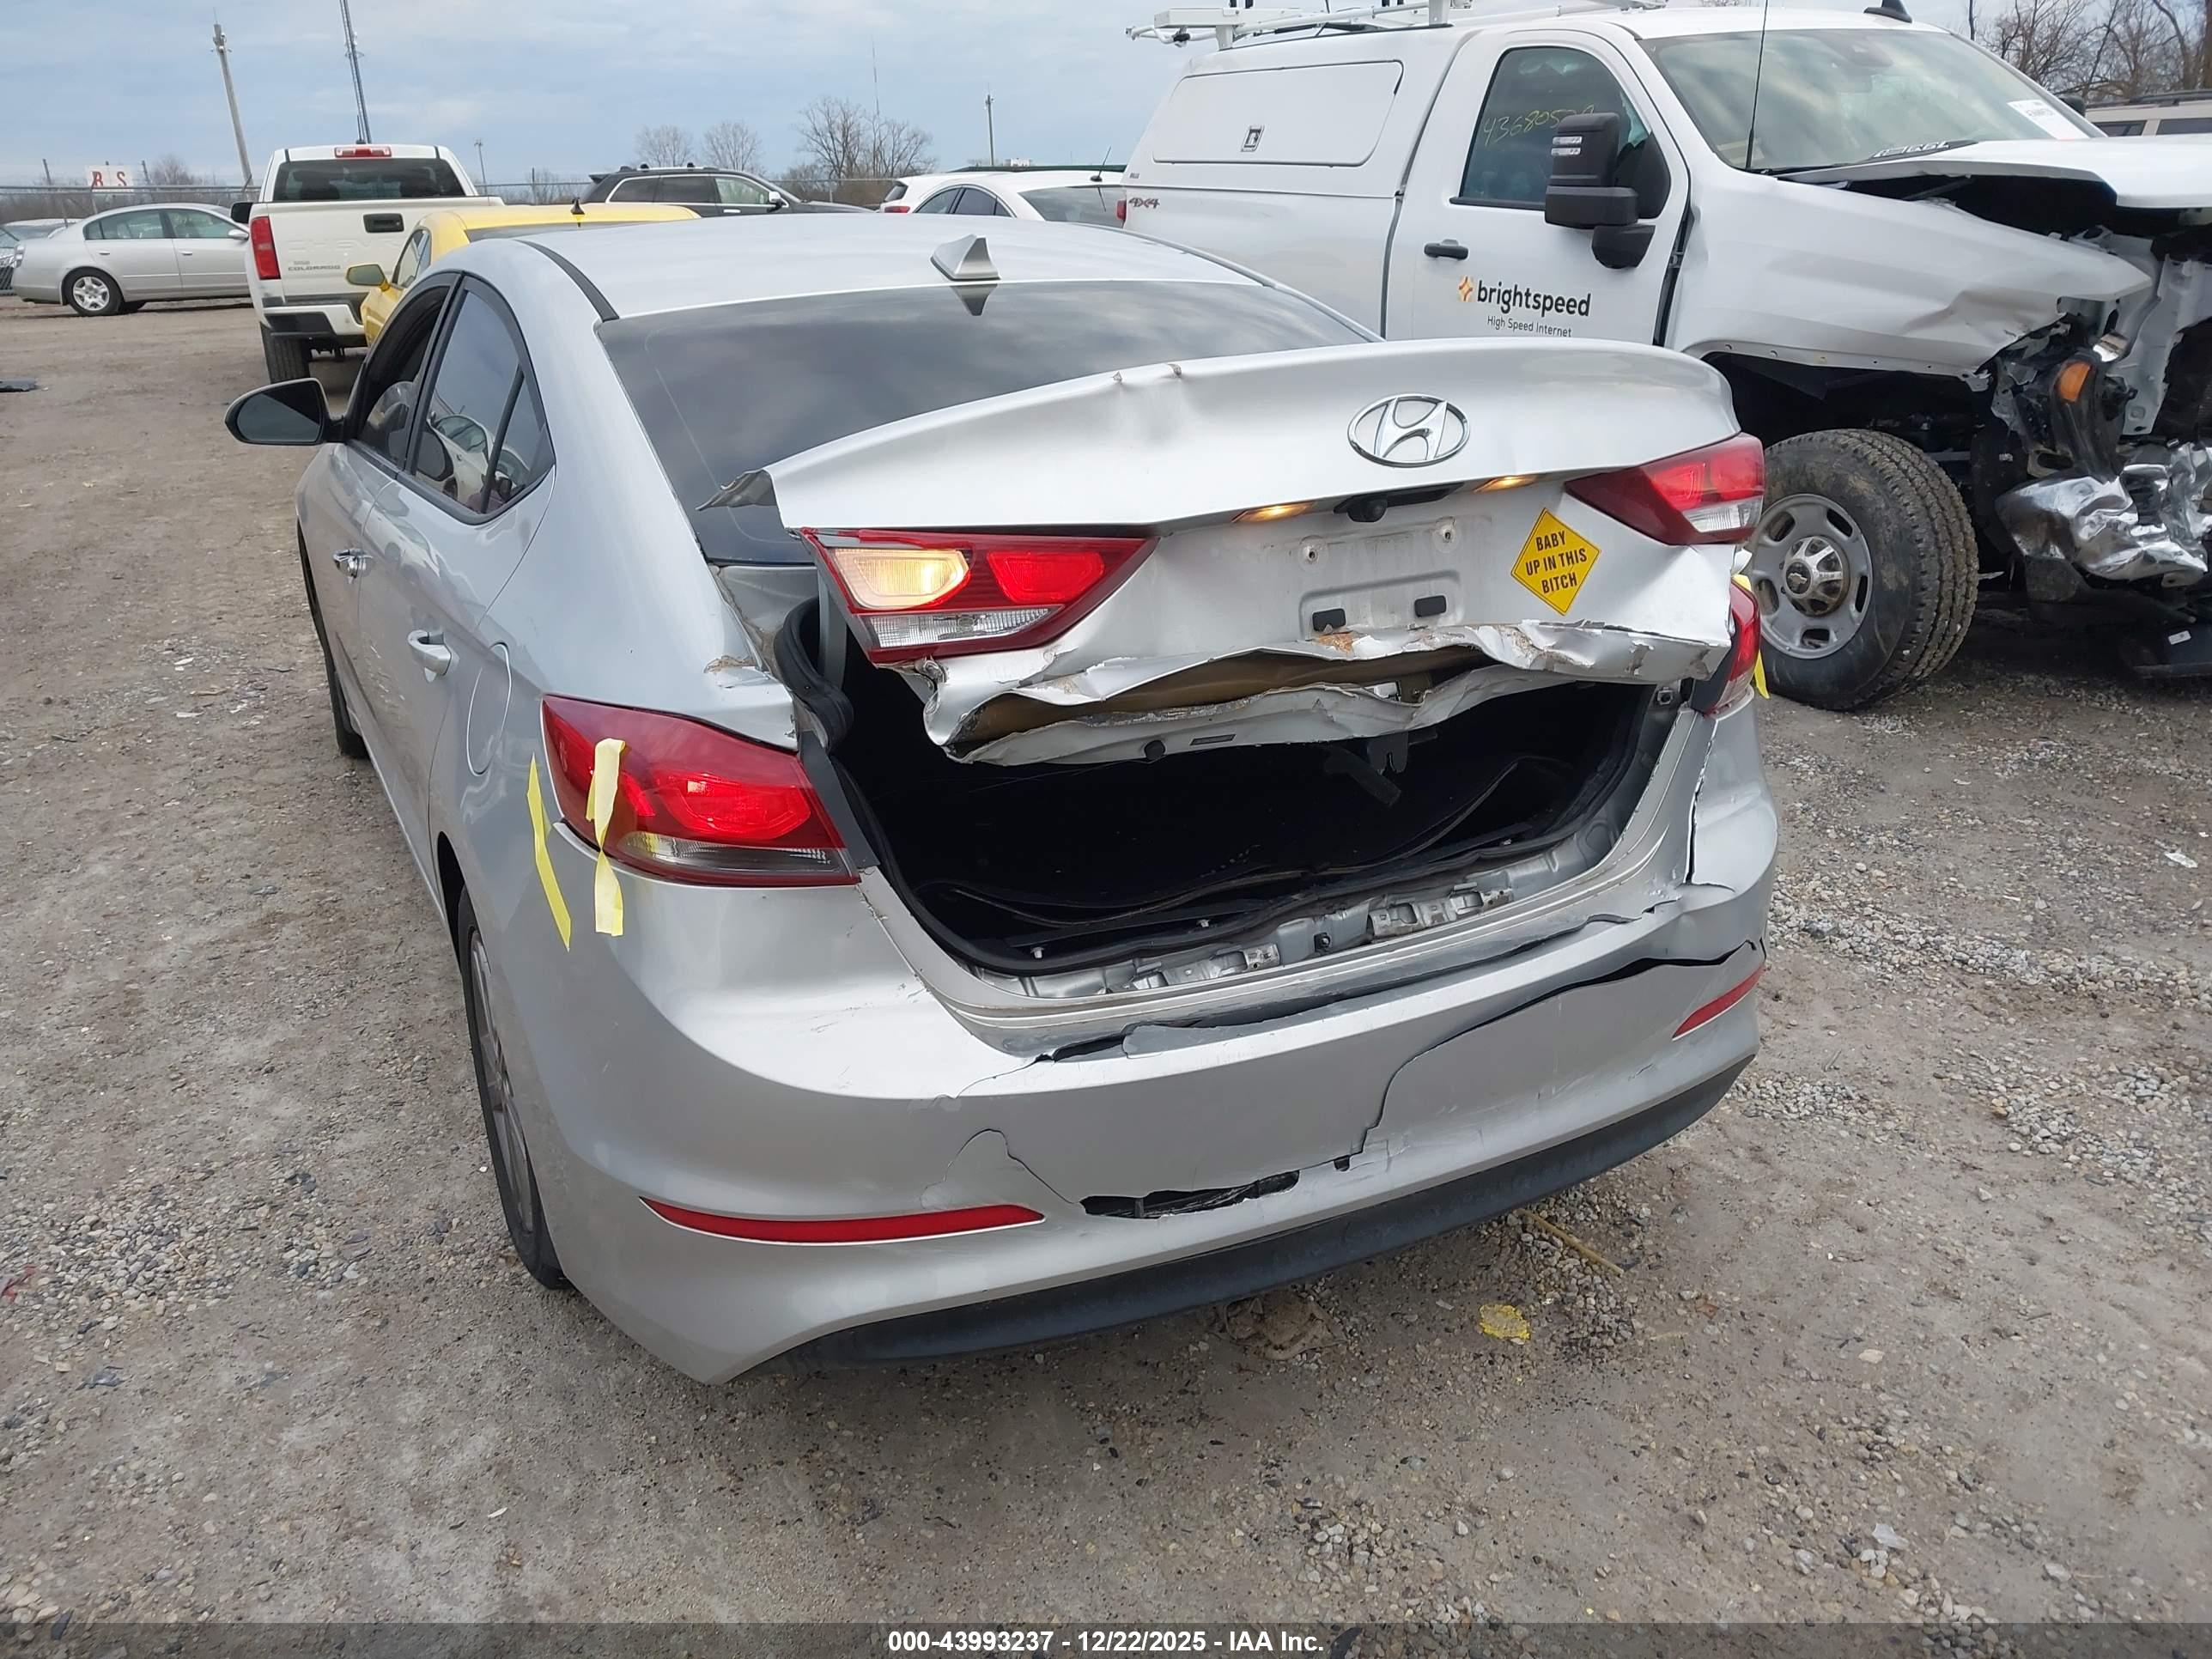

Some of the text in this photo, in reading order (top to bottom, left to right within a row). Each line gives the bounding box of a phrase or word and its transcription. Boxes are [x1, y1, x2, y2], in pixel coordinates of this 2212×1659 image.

[1484, 105, 1595, 144] 436805
[1477, 280, 1591, 318] brightspeed
[1487, 315, 1572, 337] High Speed Internet
[1535, 530, 1565, 551] BABY
[1525, 548, 1587, 576] UP IN THIS
[1541, 572, 1577, 594] BITCH
